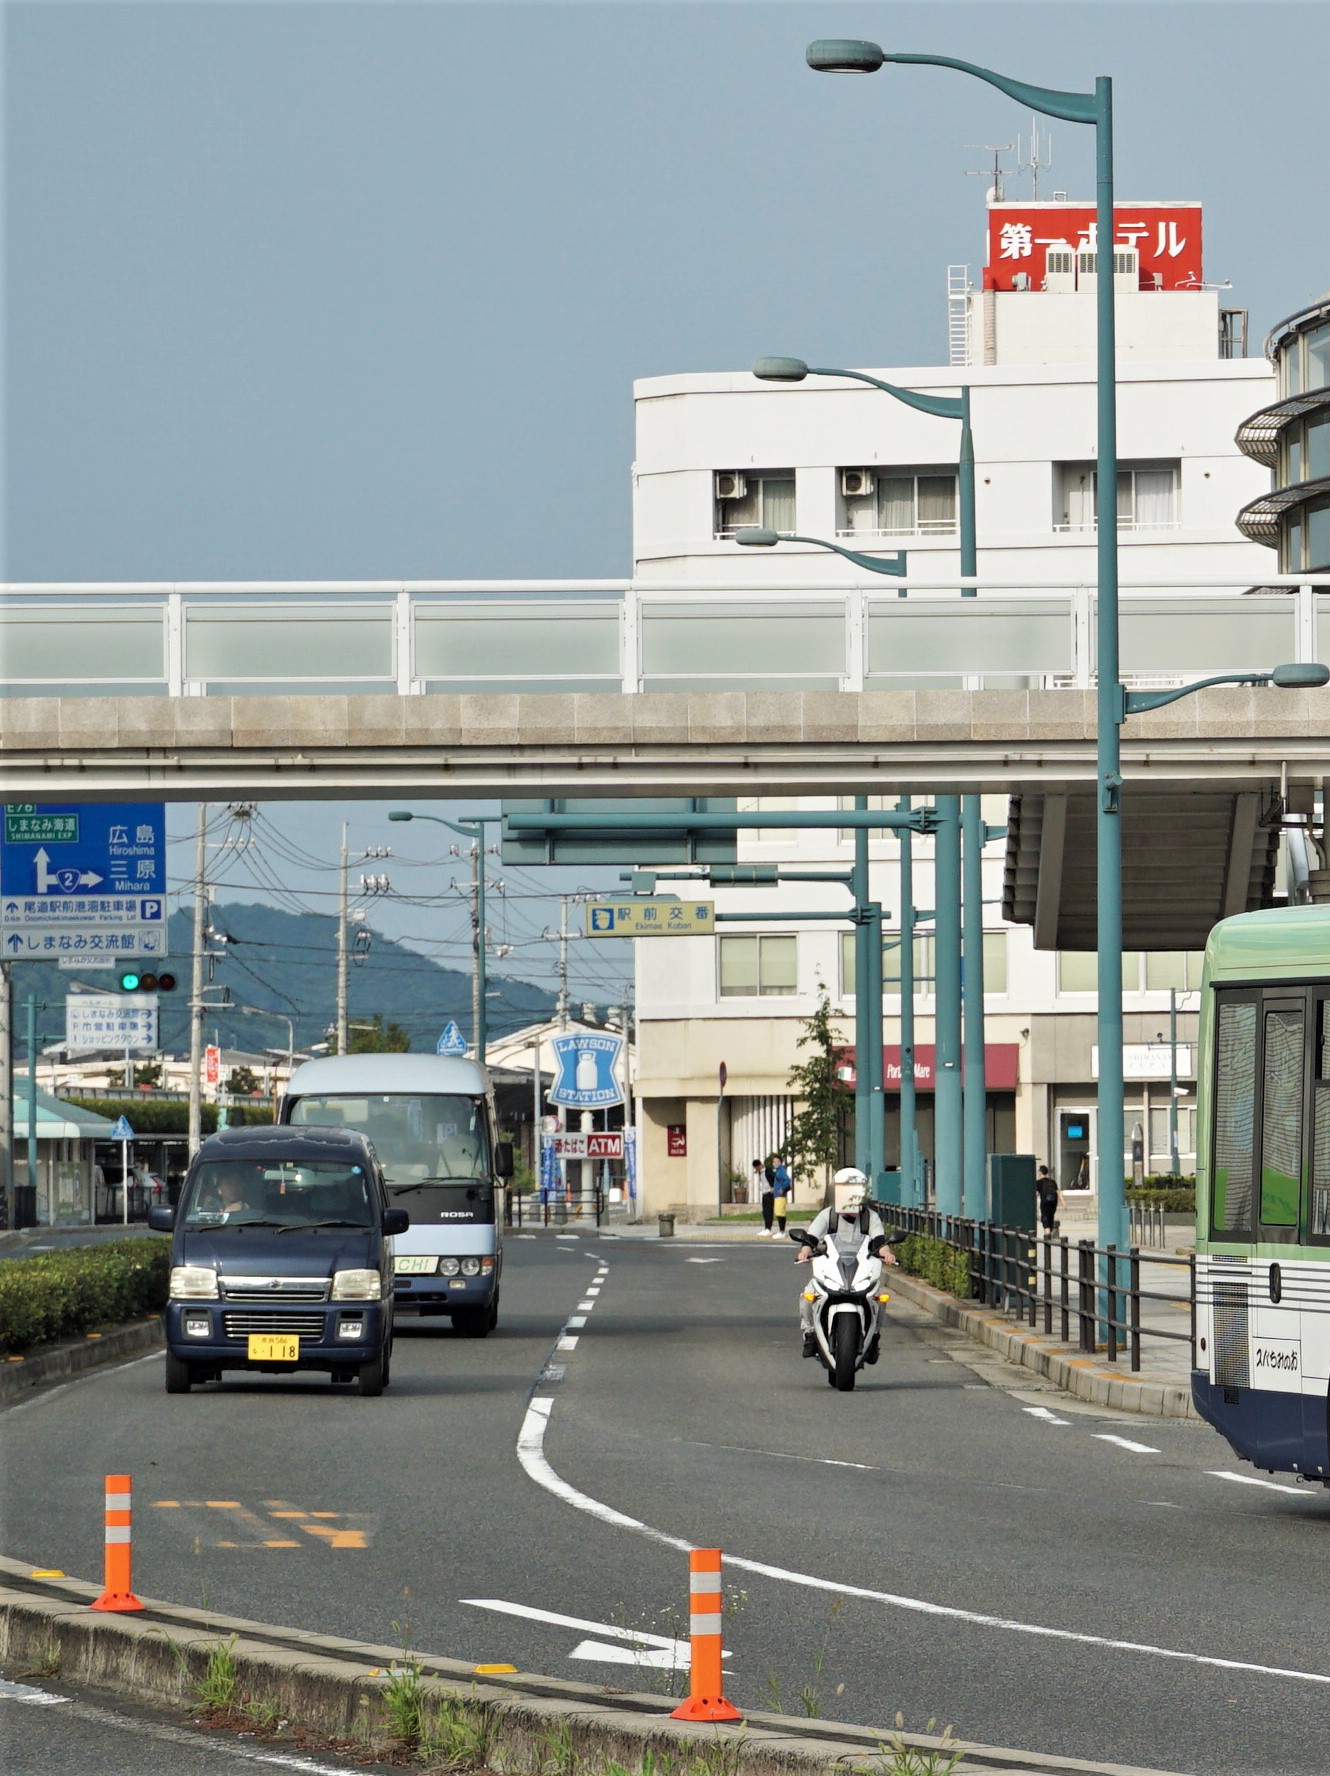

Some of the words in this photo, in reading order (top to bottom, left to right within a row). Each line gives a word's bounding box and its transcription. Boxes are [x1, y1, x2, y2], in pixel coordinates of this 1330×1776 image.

[8, 817, 76, 832] しまなみ海道
[109, 824, 155, 844] 広島
[109, 845, 155, 856] Hiroshima
[110, 860, 156, 880] 三原
[64, 873, 73, 886] 2
[115, 881, 150, 891] Mihara
[617, 906, 709, 921] 駅前交番
[635, 922, 663, 931] Ekimae
[667, 921, 692, 930] Koban
[28, 933, 136, 950] しまなみ交流館
[557, 1038, 616, 1053] LAWSON
[557, 1087, 616, 1101] STATION
[588, 1138, 620, 1154] ATM
[398, 1258, 429, 1271] CHI
